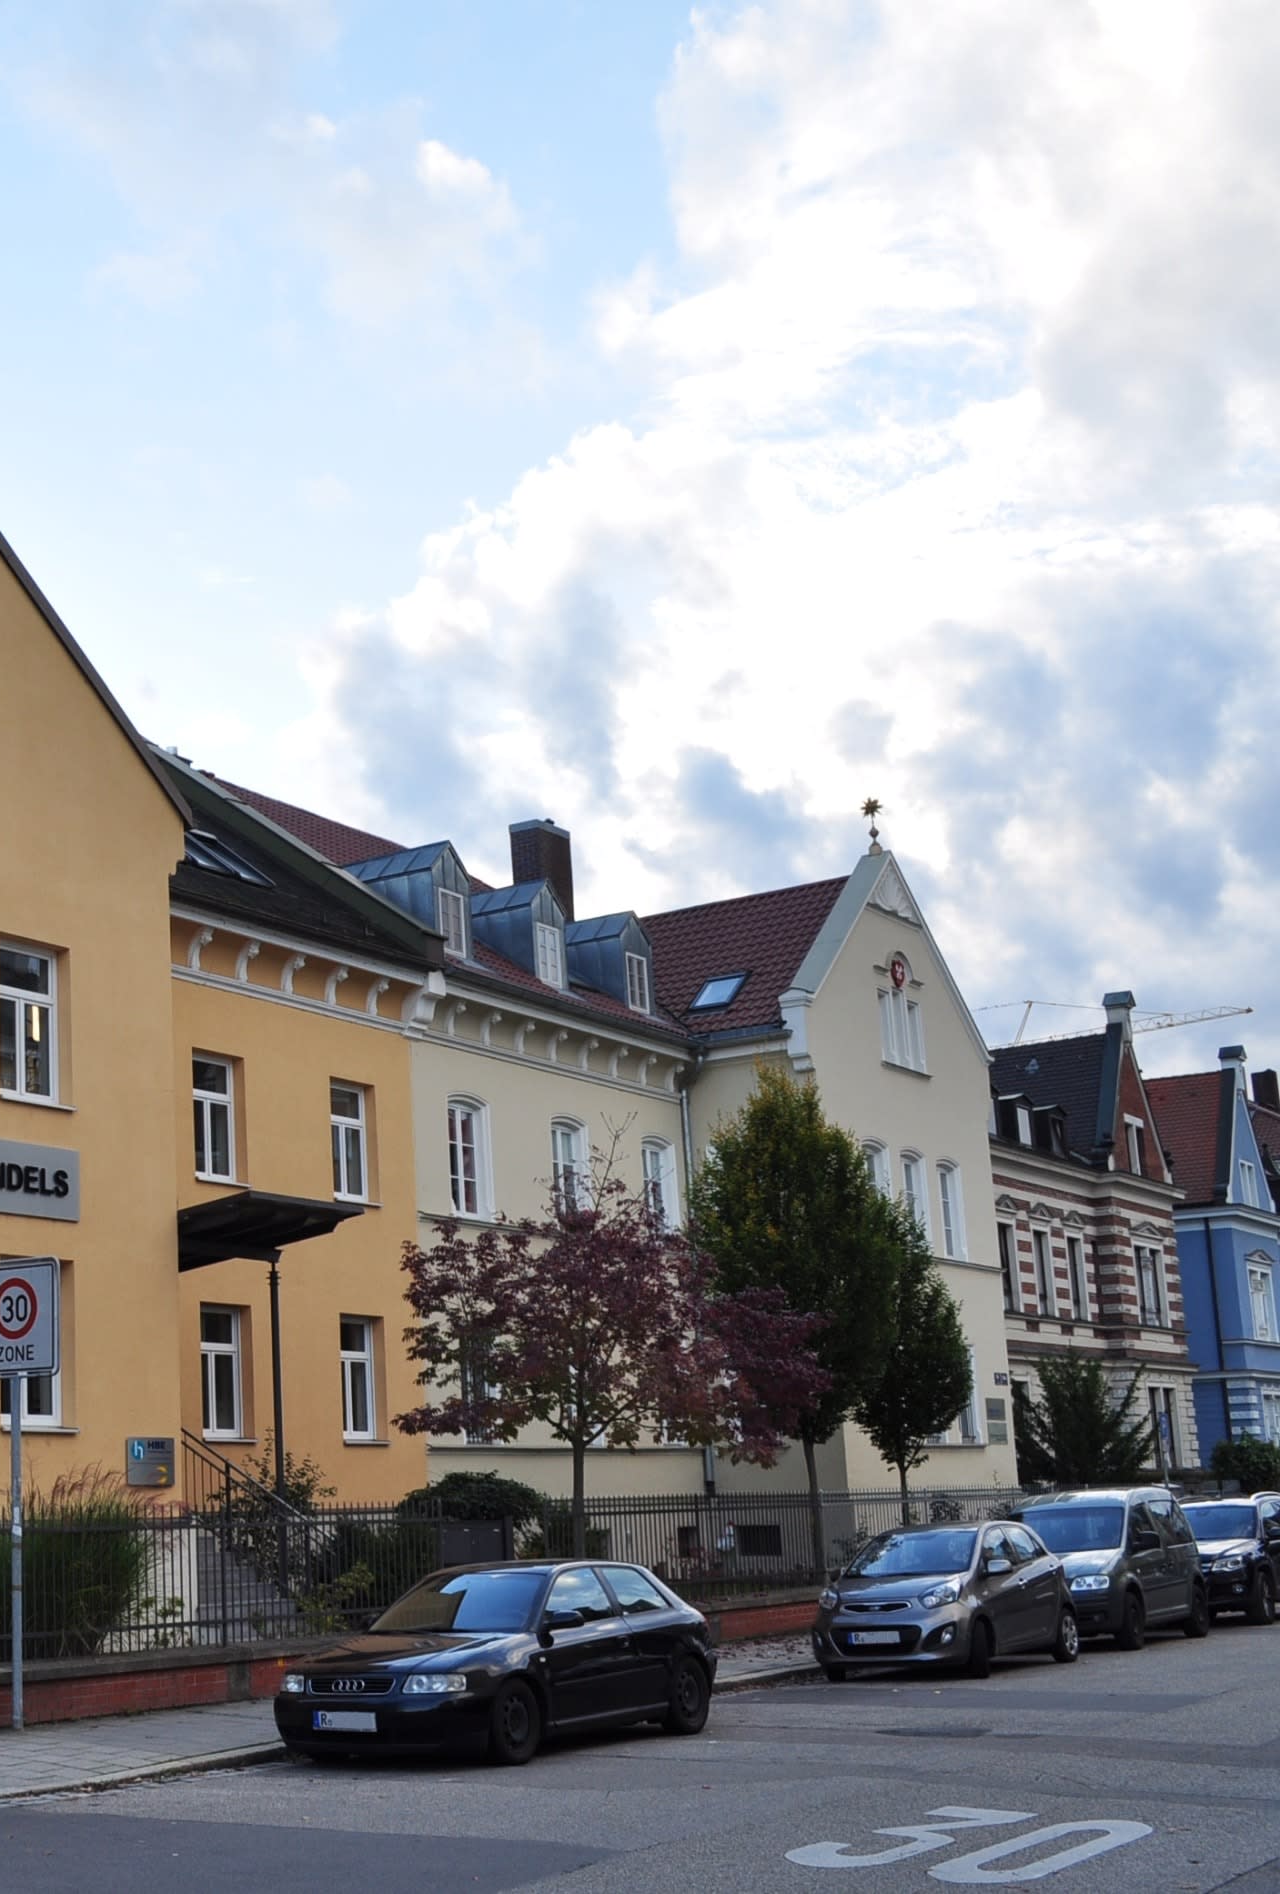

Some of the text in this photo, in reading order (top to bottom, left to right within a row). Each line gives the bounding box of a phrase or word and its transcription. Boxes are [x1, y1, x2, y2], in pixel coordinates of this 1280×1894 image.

[1, 1294, 28, 1323] 30
[320, 1712, 328, 1727] R
[784, 1805, 1153, 1884] 30
